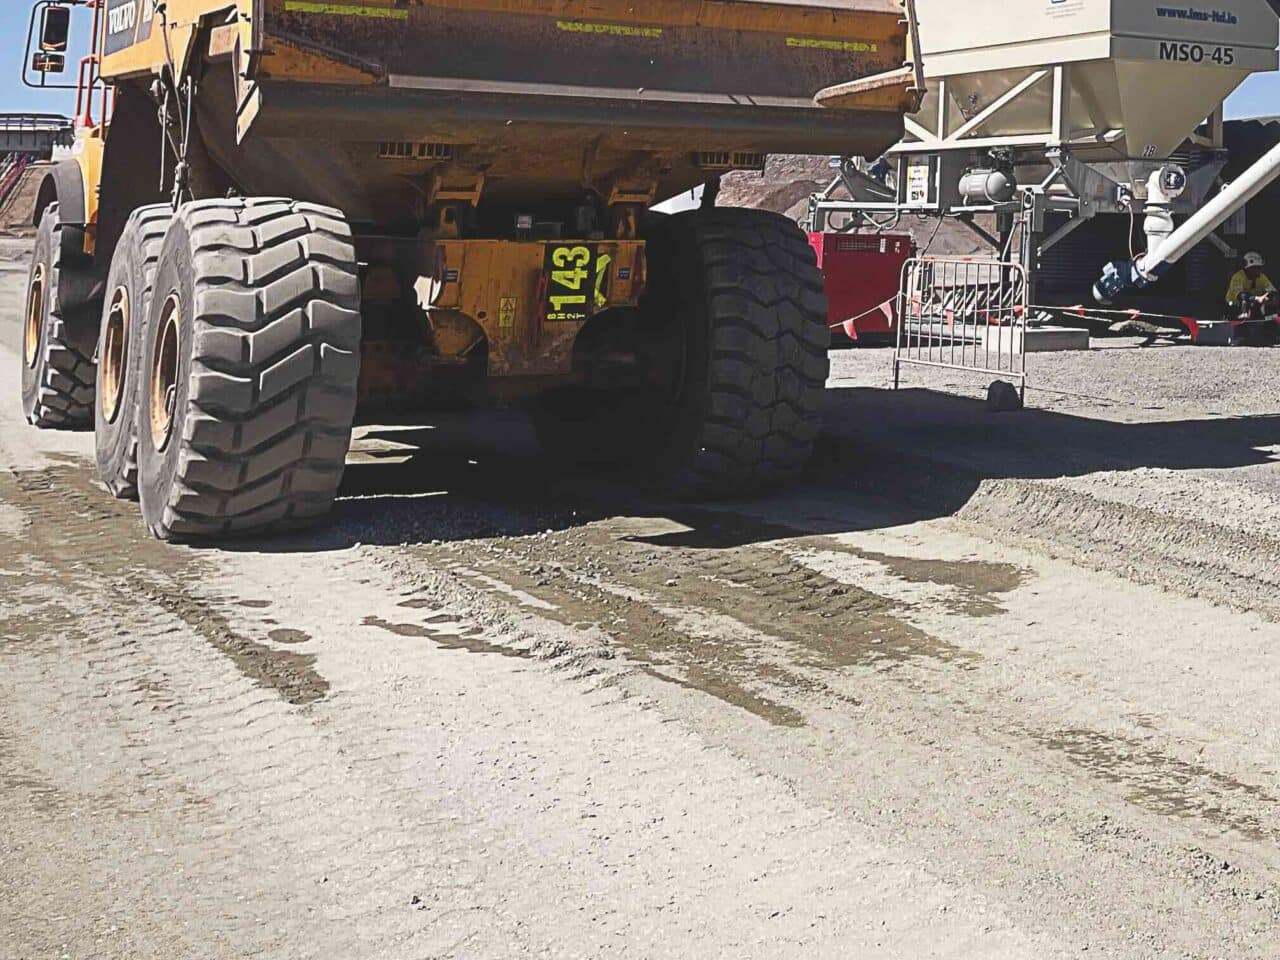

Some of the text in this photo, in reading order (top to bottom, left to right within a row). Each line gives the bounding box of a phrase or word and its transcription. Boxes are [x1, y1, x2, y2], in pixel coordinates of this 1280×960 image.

[109, 0, 135, 35] VOLVO
[1156, 7, 1238, 25] www.ims-ltd.ie
[1159, 42, 1235, 66] MSO-45
[550, 246, 591, 311] 143
